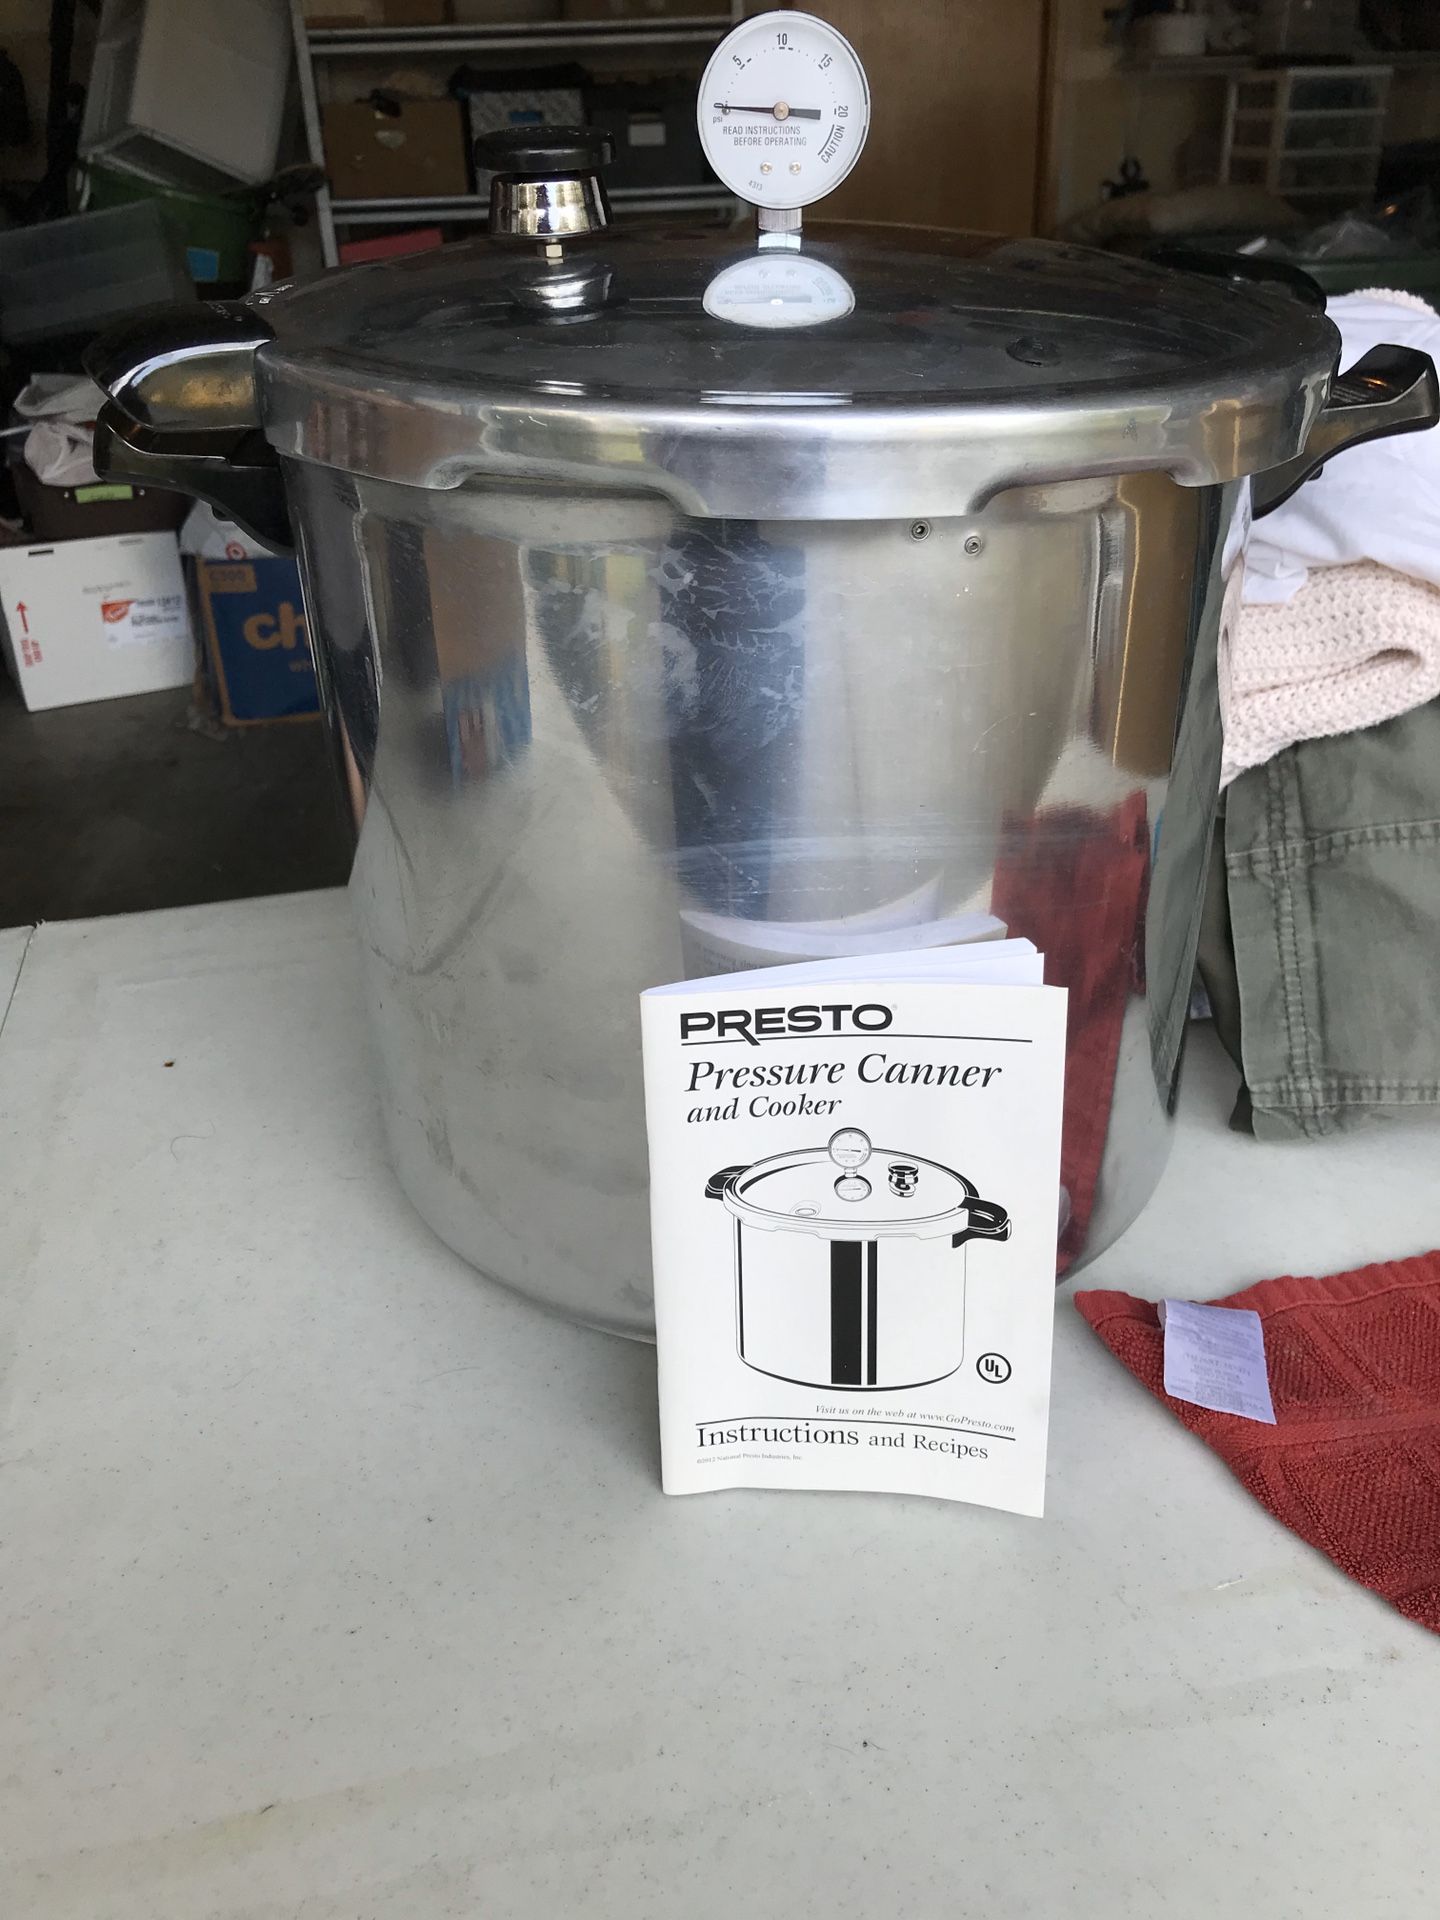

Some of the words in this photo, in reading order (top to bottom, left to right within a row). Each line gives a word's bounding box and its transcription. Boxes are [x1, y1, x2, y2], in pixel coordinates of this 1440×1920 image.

[776, 33, 788, 46] 10
[732, 55, 742, 66] 5
[820, 53, 833, 68] 15
[712, 116, 723, 124] psi
[837, 105, 849, 118] 20
[722, 126, 744, 135] READ
[745, 126, 800, 135] INSTRUCTIONS
[733, 136, 763, 146] BEFORE
[764, 136, 807, 146] OPERATING
[820, 125, 846, 164] CAUTION
[680, 1003, 893, 1046] PRESTO
[684, 1060, 845, 1092] Pressure
[857, 1053, 1002, 1089] Canner
[687, 1098, 740, 1123] and
[748, 1094, 842, 1118] Cooker
[985, 1358, 1003, 1379] UL
[815, 1405, 836, 1414] Visit
[851, 1408, 865, 1416] on
[867, 1407, 882, 1417] the
[884, 1409, 904, 1418] web
[906, 1411, 917, 1419] at
[919, 1412, 1015, 1433] www.GoPresto.com
[697, 1422, 859, 1448] Instructions
[868, 1432, 905, 1448] and
[913, 1433, 989, 1459] Recipes
